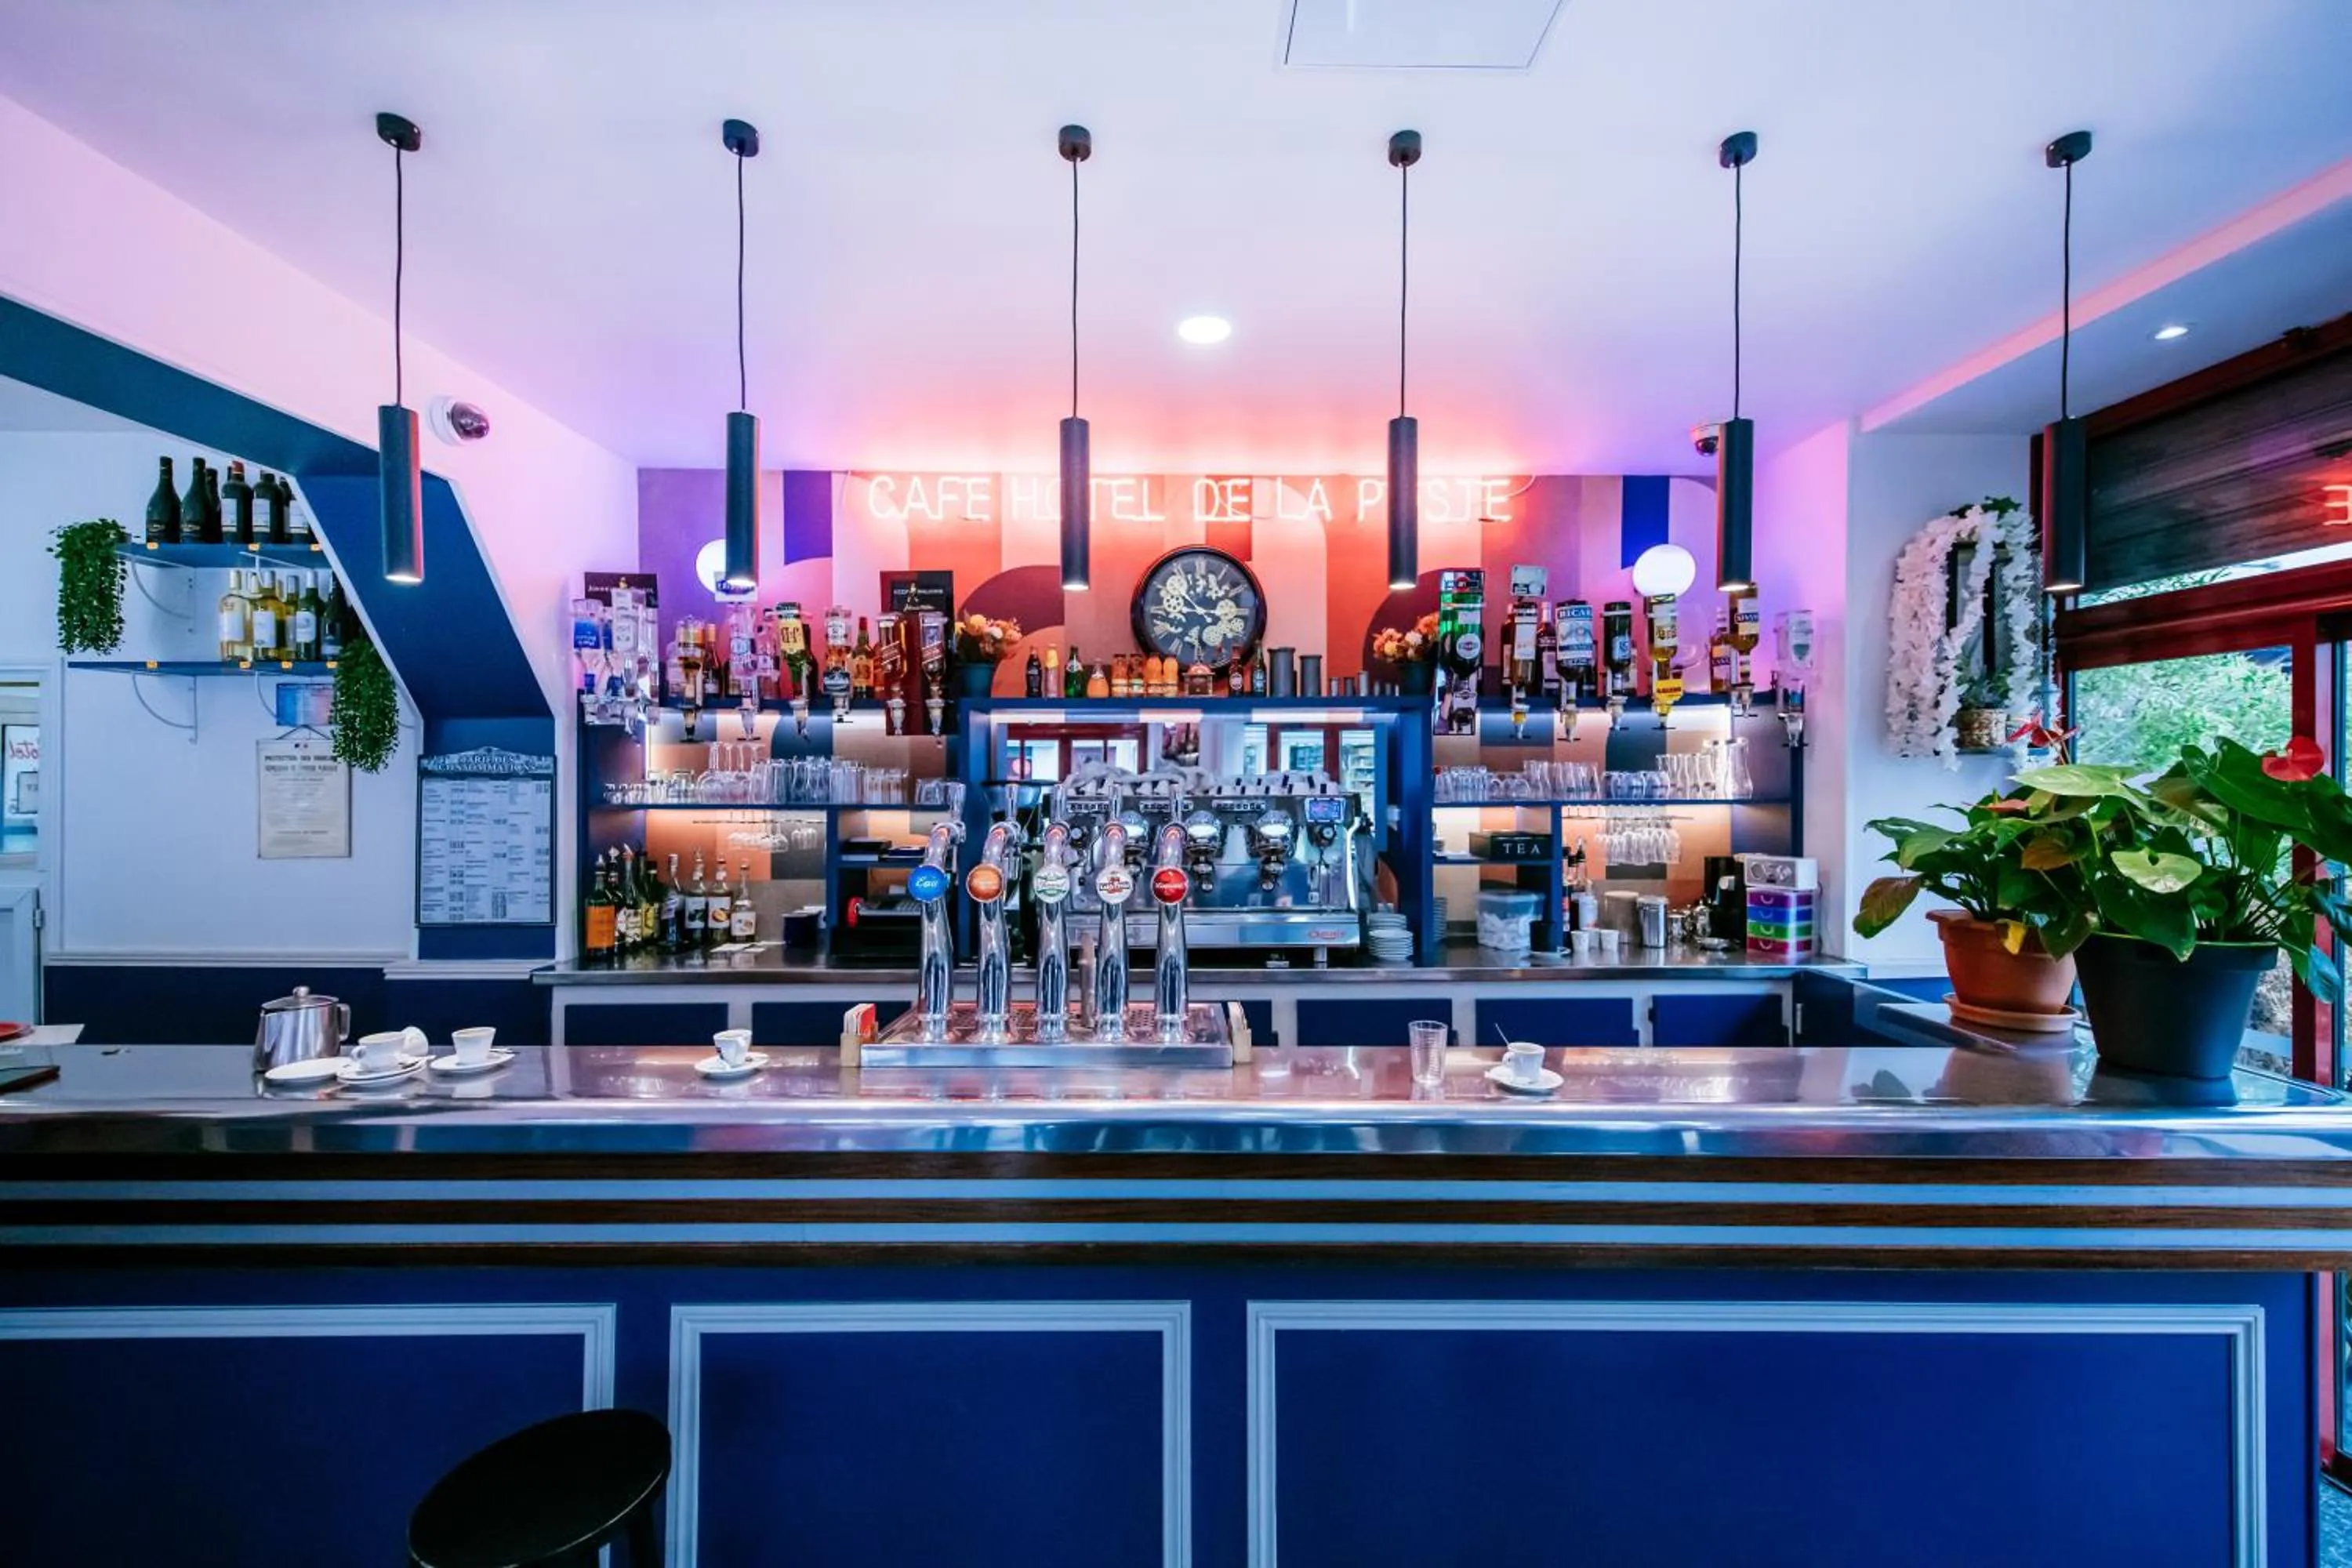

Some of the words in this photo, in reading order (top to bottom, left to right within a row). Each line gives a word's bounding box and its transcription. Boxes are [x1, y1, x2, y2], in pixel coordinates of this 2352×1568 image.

[868, 475, 991, 521] CAFE
[1192, 478, 1251, 521] DE
[1276, 477, 1332, 521] LA
[1357, 478, 1512, 523] PSTE
[1502, 843, 1541, 854] TEA
